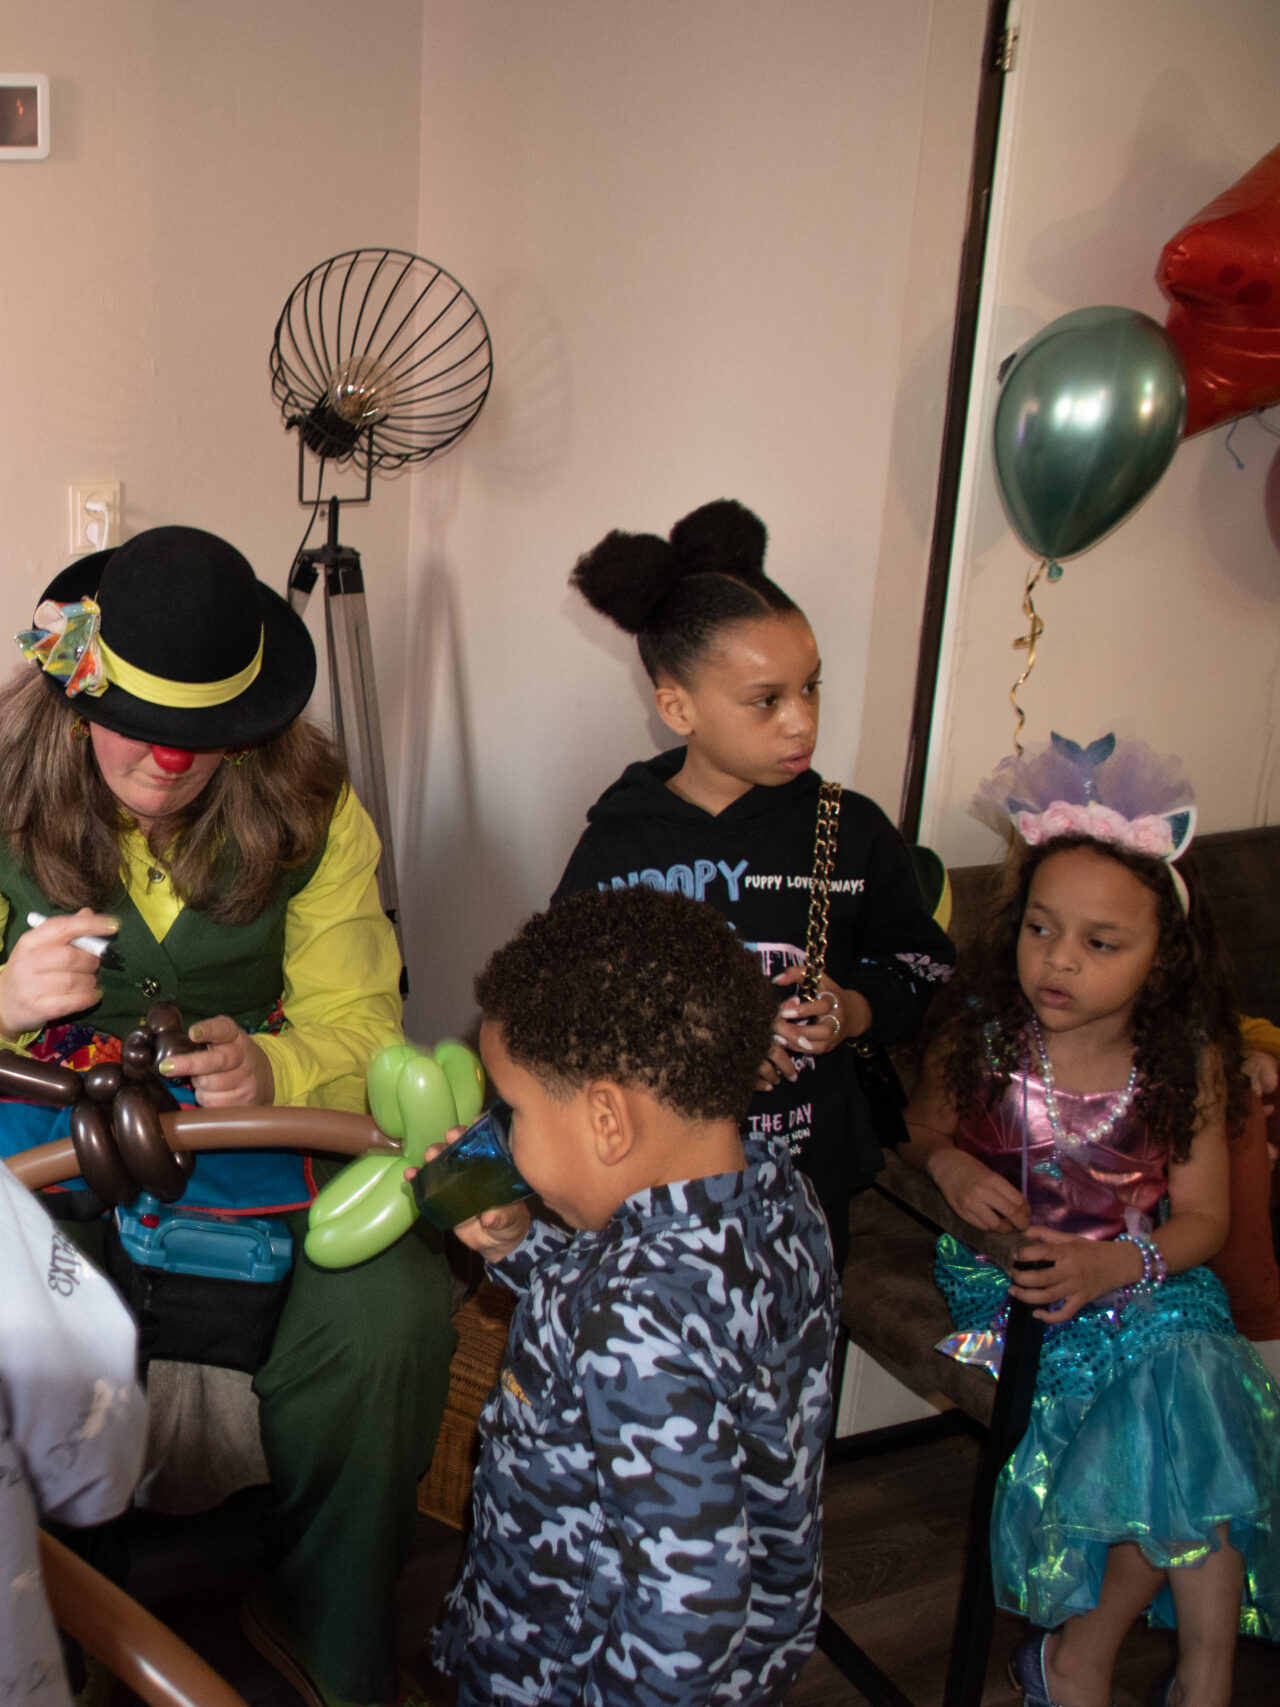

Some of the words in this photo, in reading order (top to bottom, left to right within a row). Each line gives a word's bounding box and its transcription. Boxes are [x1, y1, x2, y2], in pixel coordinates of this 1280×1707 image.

[744, 874, 783, 891] PUPPY
[786, 875, 814, 889] LOVE
[748, 1113, 783, 1133] THE
[789, 1103, 812, 1128] DAY
